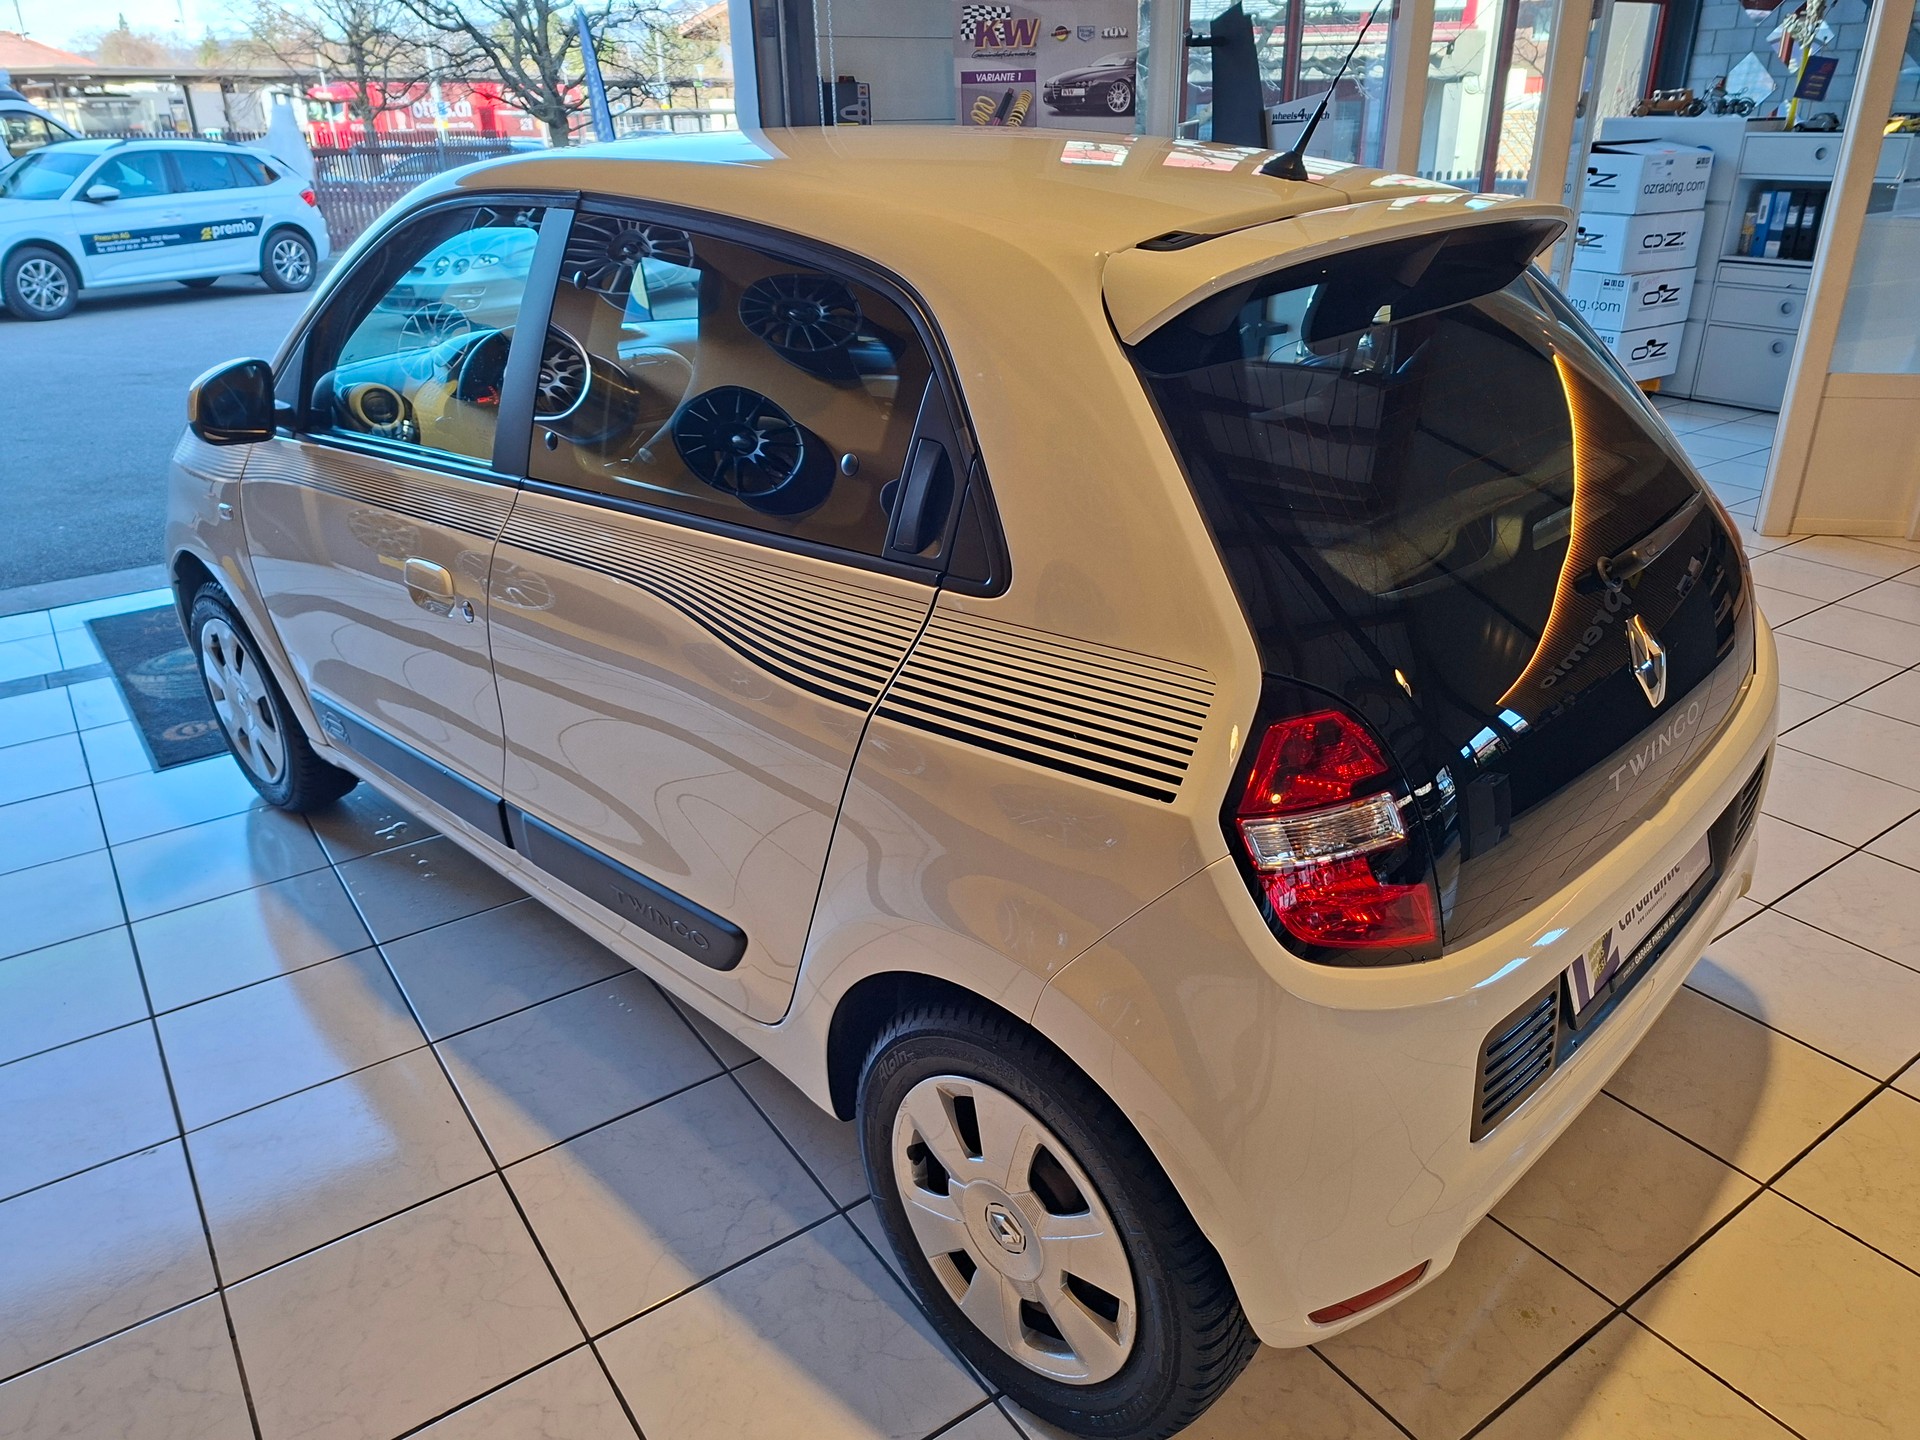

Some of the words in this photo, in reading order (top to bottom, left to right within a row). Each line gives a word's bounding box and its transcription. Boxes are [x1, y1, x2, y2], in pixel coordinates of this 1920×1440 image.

[974, 18, 1041, 48] KW
[1102, 26, 1128, 37] TÜV
[975, 73, 1016, 83] VARIANTE
[1017, 72, 1023, 81] 1
[1643, 180, 1706, 196] ozracing.com
[212, 219, 256, 239] premio
[1608, 701, 1700, 792] TWINGO
[608, 881, 711, 951] TWINGO
[1634, 940, 1653, 965] GARAGE
